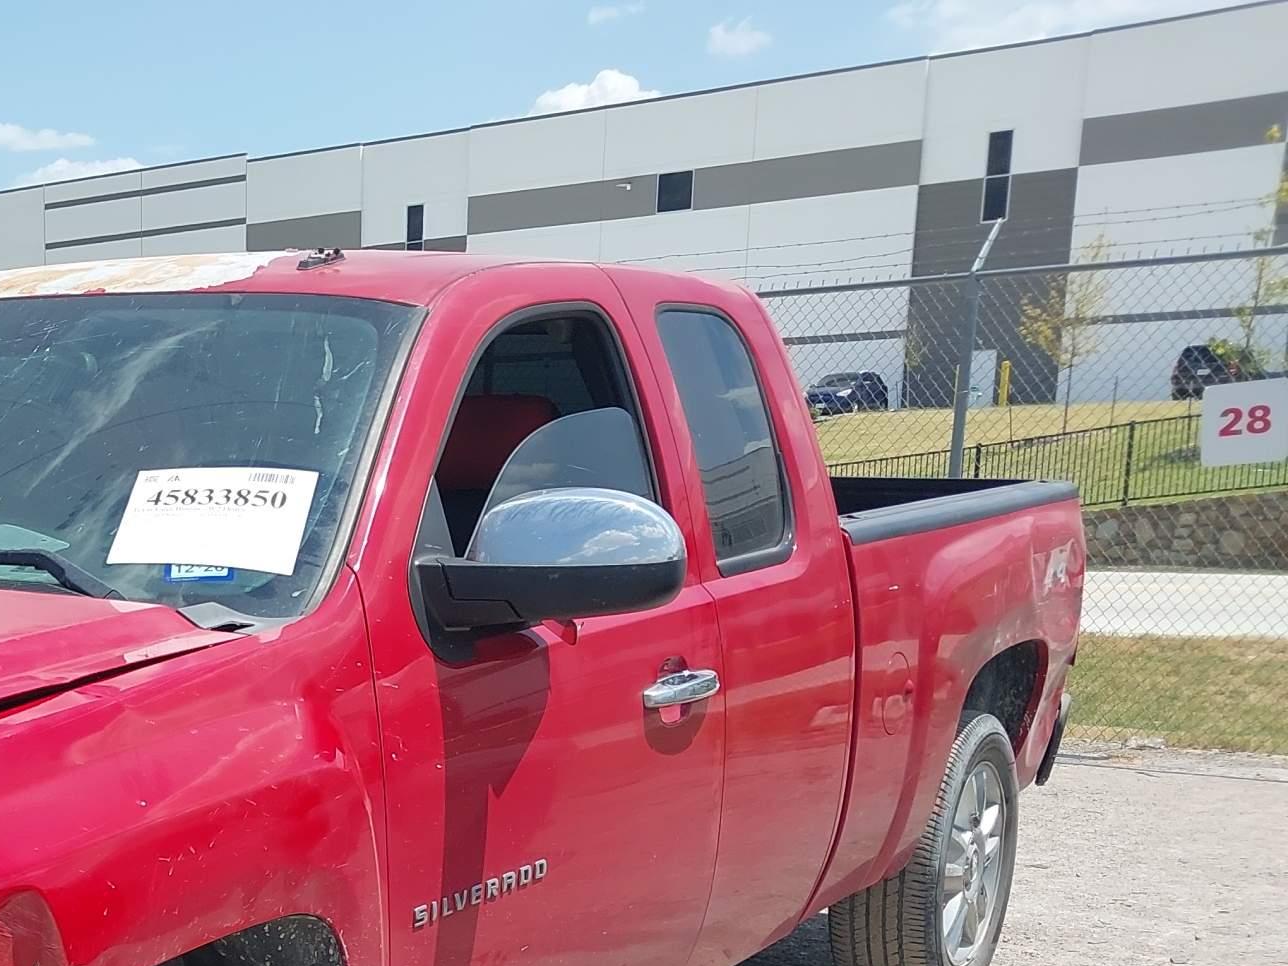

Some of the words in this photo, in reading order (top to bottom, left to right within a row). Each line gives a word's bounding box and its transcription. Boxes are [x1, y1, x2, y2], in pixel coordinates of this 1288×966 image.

[1218, 405, 1272, 437] 28
[146, 488, 288, 509] 45833850
[413, 858, 548, 928] SILVERADO
